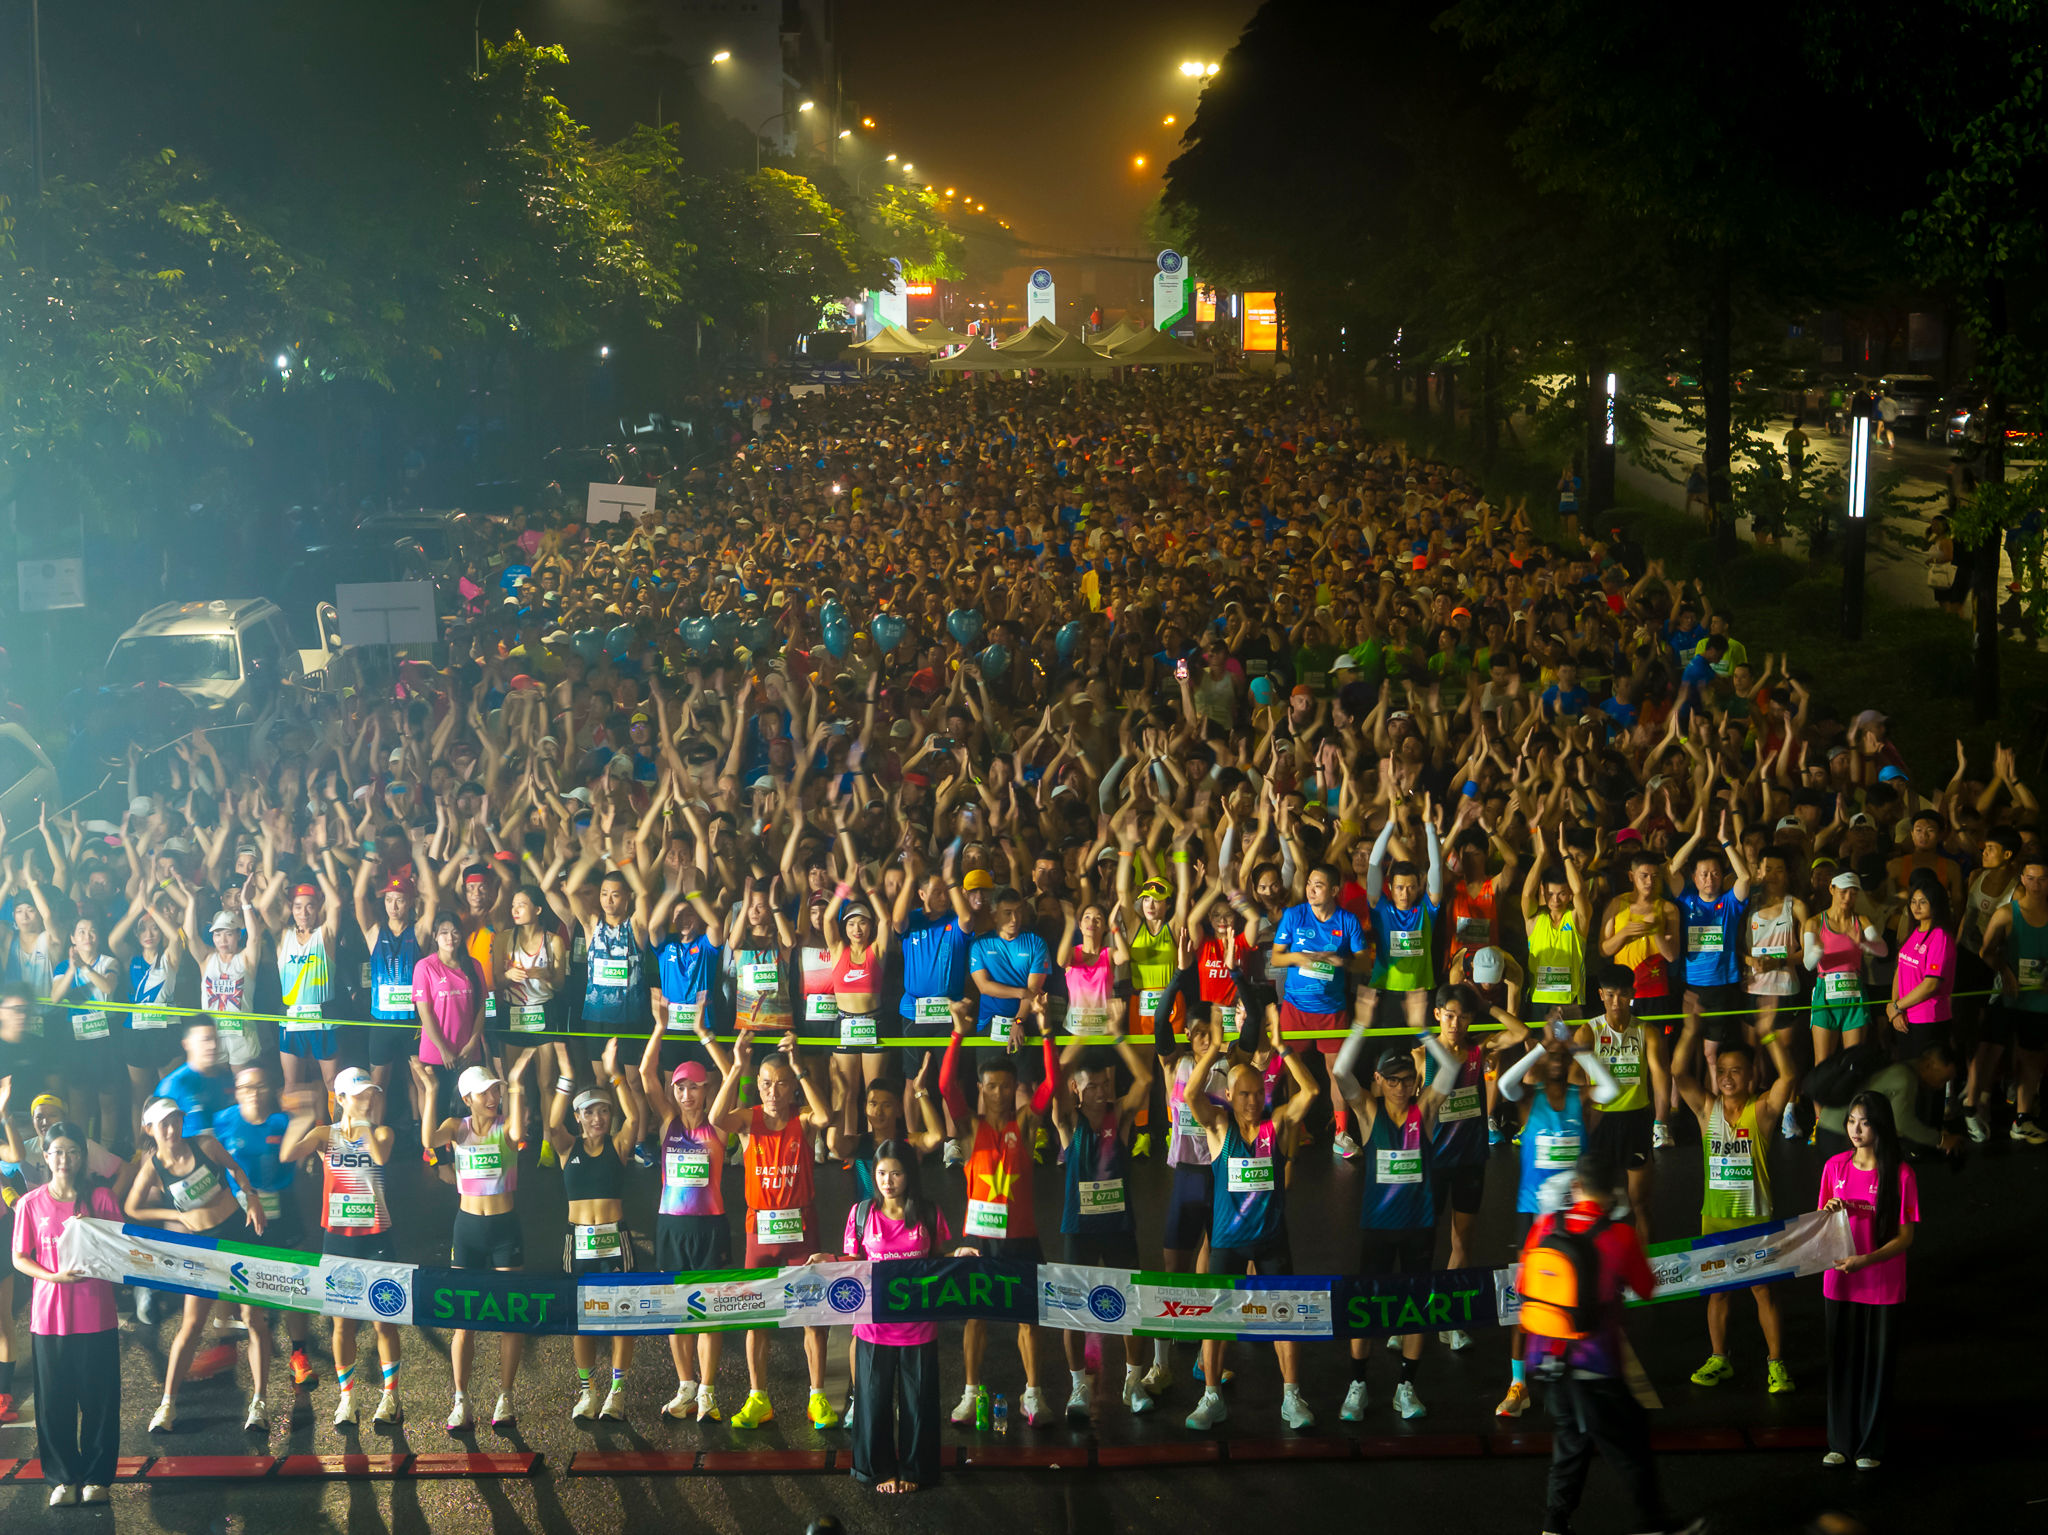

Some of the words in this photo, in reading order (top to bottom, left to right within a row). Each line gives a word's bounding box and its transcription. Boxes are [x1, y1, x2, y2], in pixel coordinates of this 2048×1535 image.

[1700, 934, 1722, 942] 62704
[1209, 969, 1229, 978] RU
[853, 1026, 876, 1034] 68002
[1613, 1065, 1637, 1073] 65562
[331, 1154, 372, 1168] USA
[680, 1165, 705, 1174] 67174
[755, 1166, 776, 1176] BAC
[1244, 1168, 1269, 1179] 61738
[1724, 1167, 1752, 1176] 69406
[761, 1177, 794, 1188] RUN
[345, 1205, 373, 1214] 65564
[772, 1220, 799, 1230] 63424
[590, 1236, 615, 1246] 67451
[256, 1271, 304, 1286] standard
[256, 1281, 308, 1296] chartered
[888, 1272, 1021, 1311] START
[713, 1292, 762, 1304] standard
[434, 1288, 555, 1323] START
[714, 1299, 765, 1312] chartered
[1154, 1301, 1213, 1317] XTEP
[1348, 1289, 1480, 1329] START
